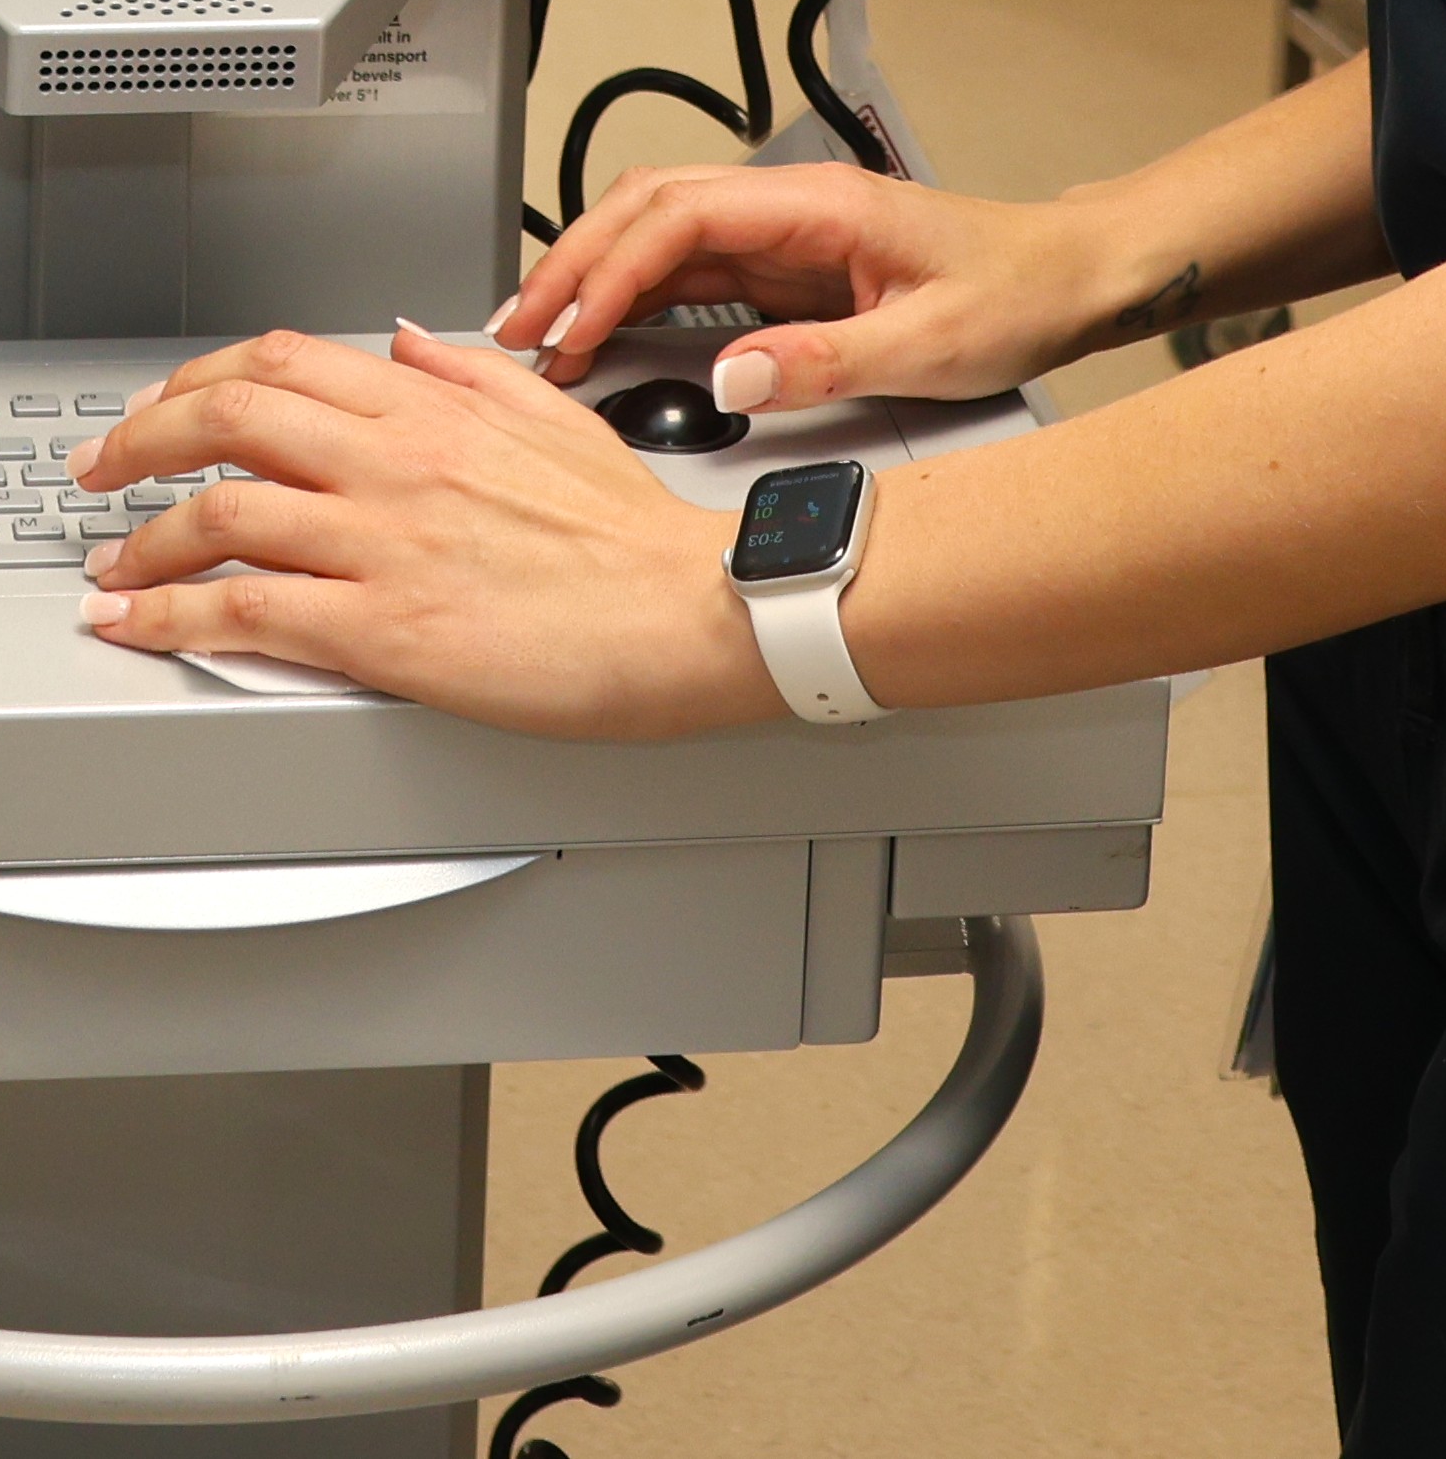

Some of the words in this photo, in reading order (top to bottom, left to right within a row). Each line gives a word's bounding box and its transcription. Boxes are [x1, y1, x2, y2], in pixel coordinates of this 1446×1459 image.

[397, 31, 412, 44] in
[361, 50, 428, 65] ransport
[352, 69, 403, 83] bevels
[757, 492, 779, 507] 03
[754, 507, 773, 520] 01
[747, 531, 785, 547] 2:03
